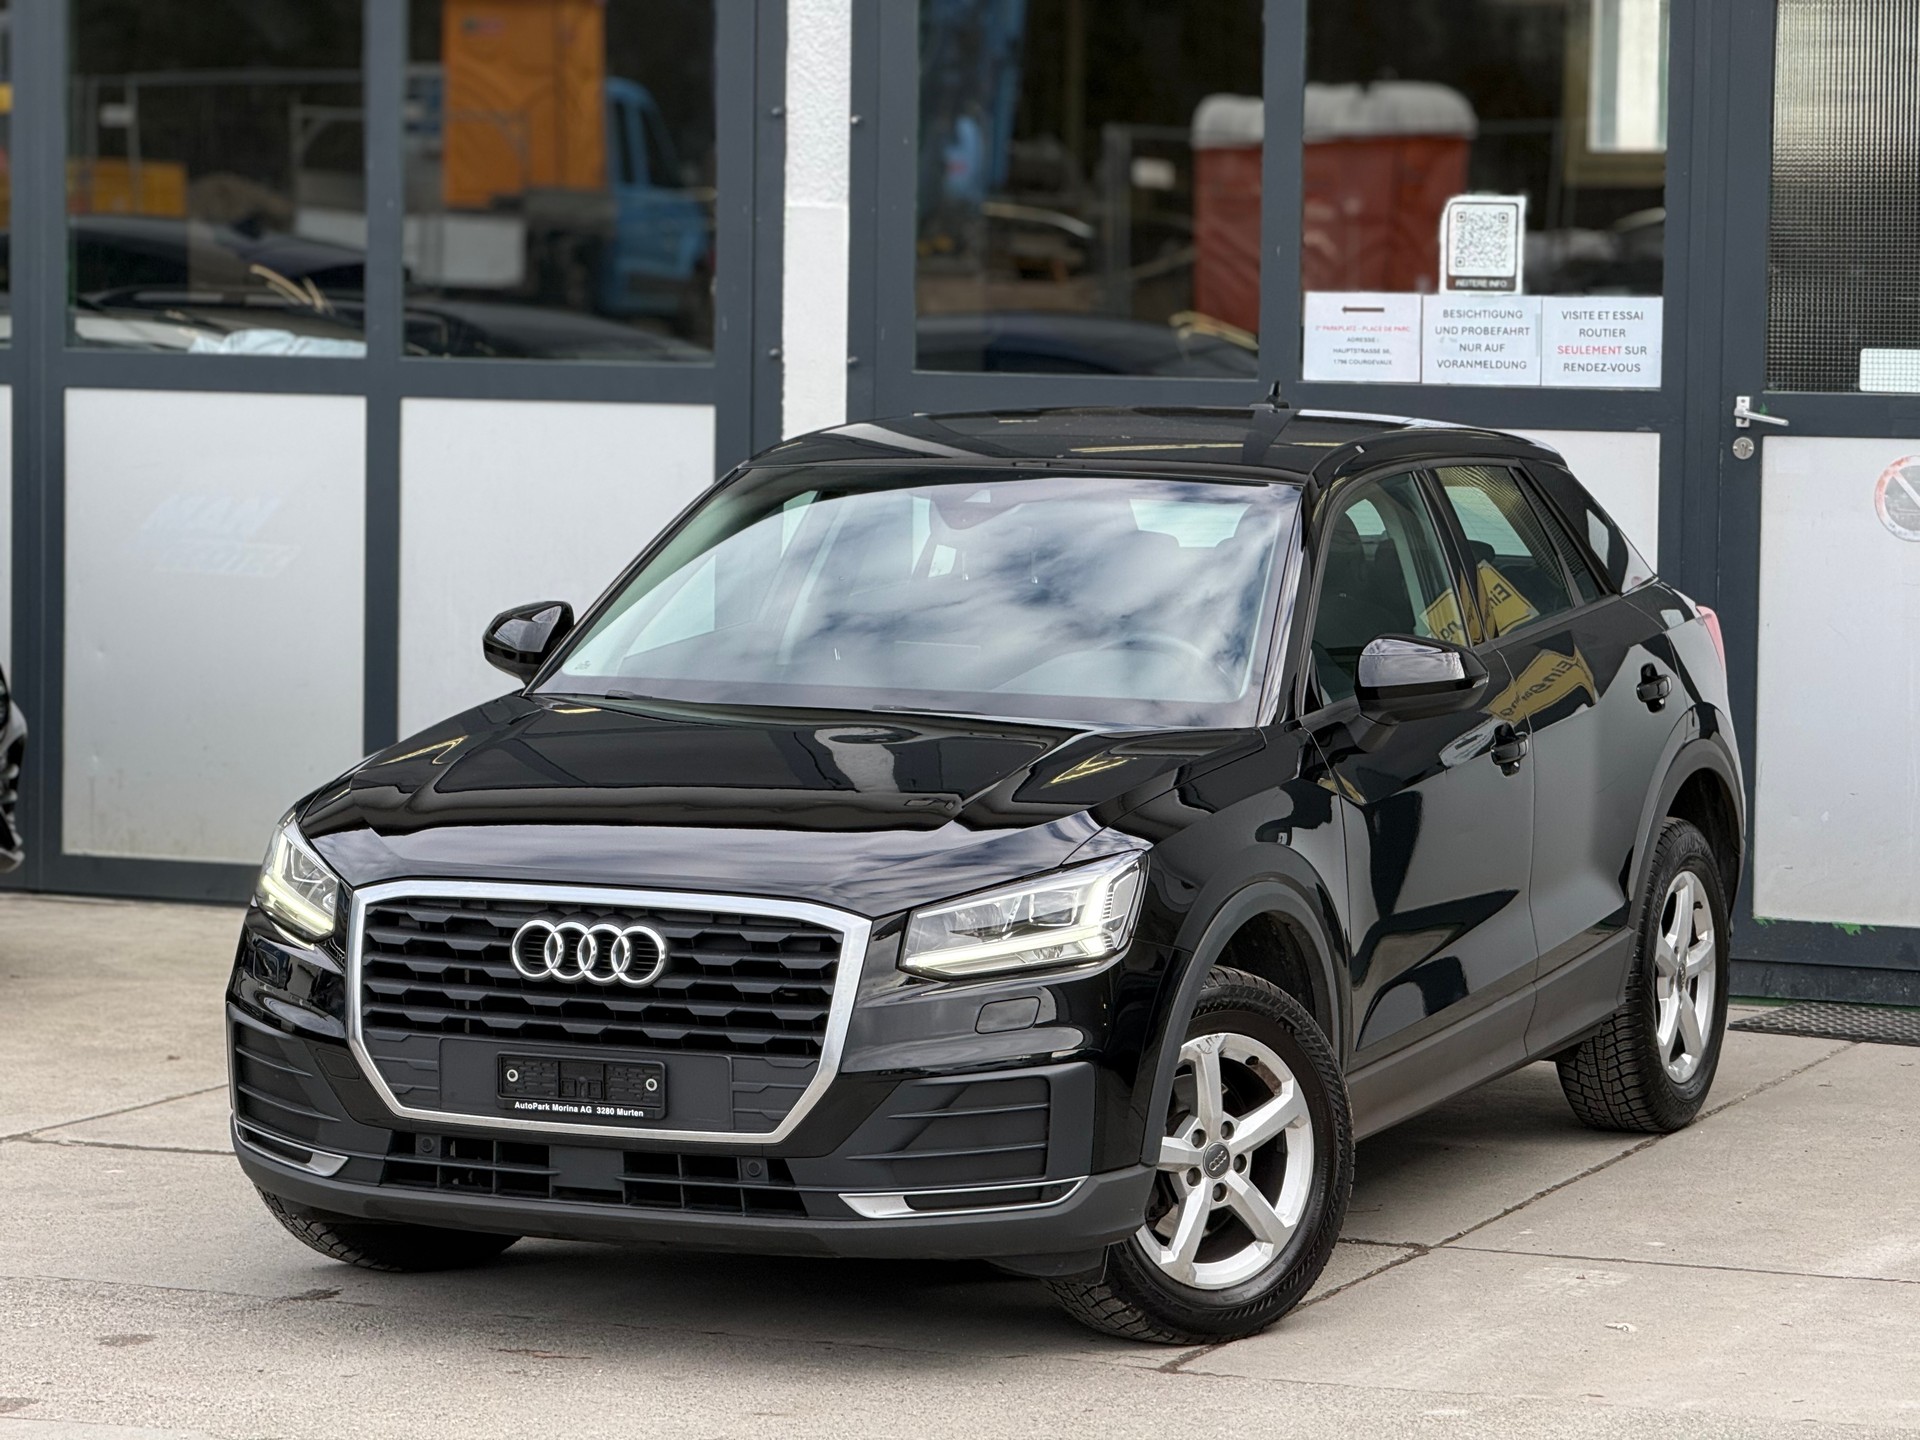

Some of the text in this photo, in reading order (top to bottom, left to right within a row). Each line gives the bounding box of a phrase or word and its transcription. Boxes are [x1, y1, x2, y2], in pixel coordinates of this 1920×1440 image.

[1442, 309, 1523, 319] BESICHTIGUNG
[1561, 311, 1644, 320] VISITE ET ESSAI
[1435, 326, 1530, 336] UND PROBEFAHRT
[1579, 328, 1626, 338] ROUTIER
[1459, 343, 1505, 352] NUR AUF
[1557, 345, 1647, 355] SEULEMENT SUR
[1437, 359, 1527, 370] VORANMELDUNG
[1563, 362, 1641, 373] RENDEZ-VOUS
[514, 1101, 644, 1117] AutoPark Morina AG 3280 Murten
